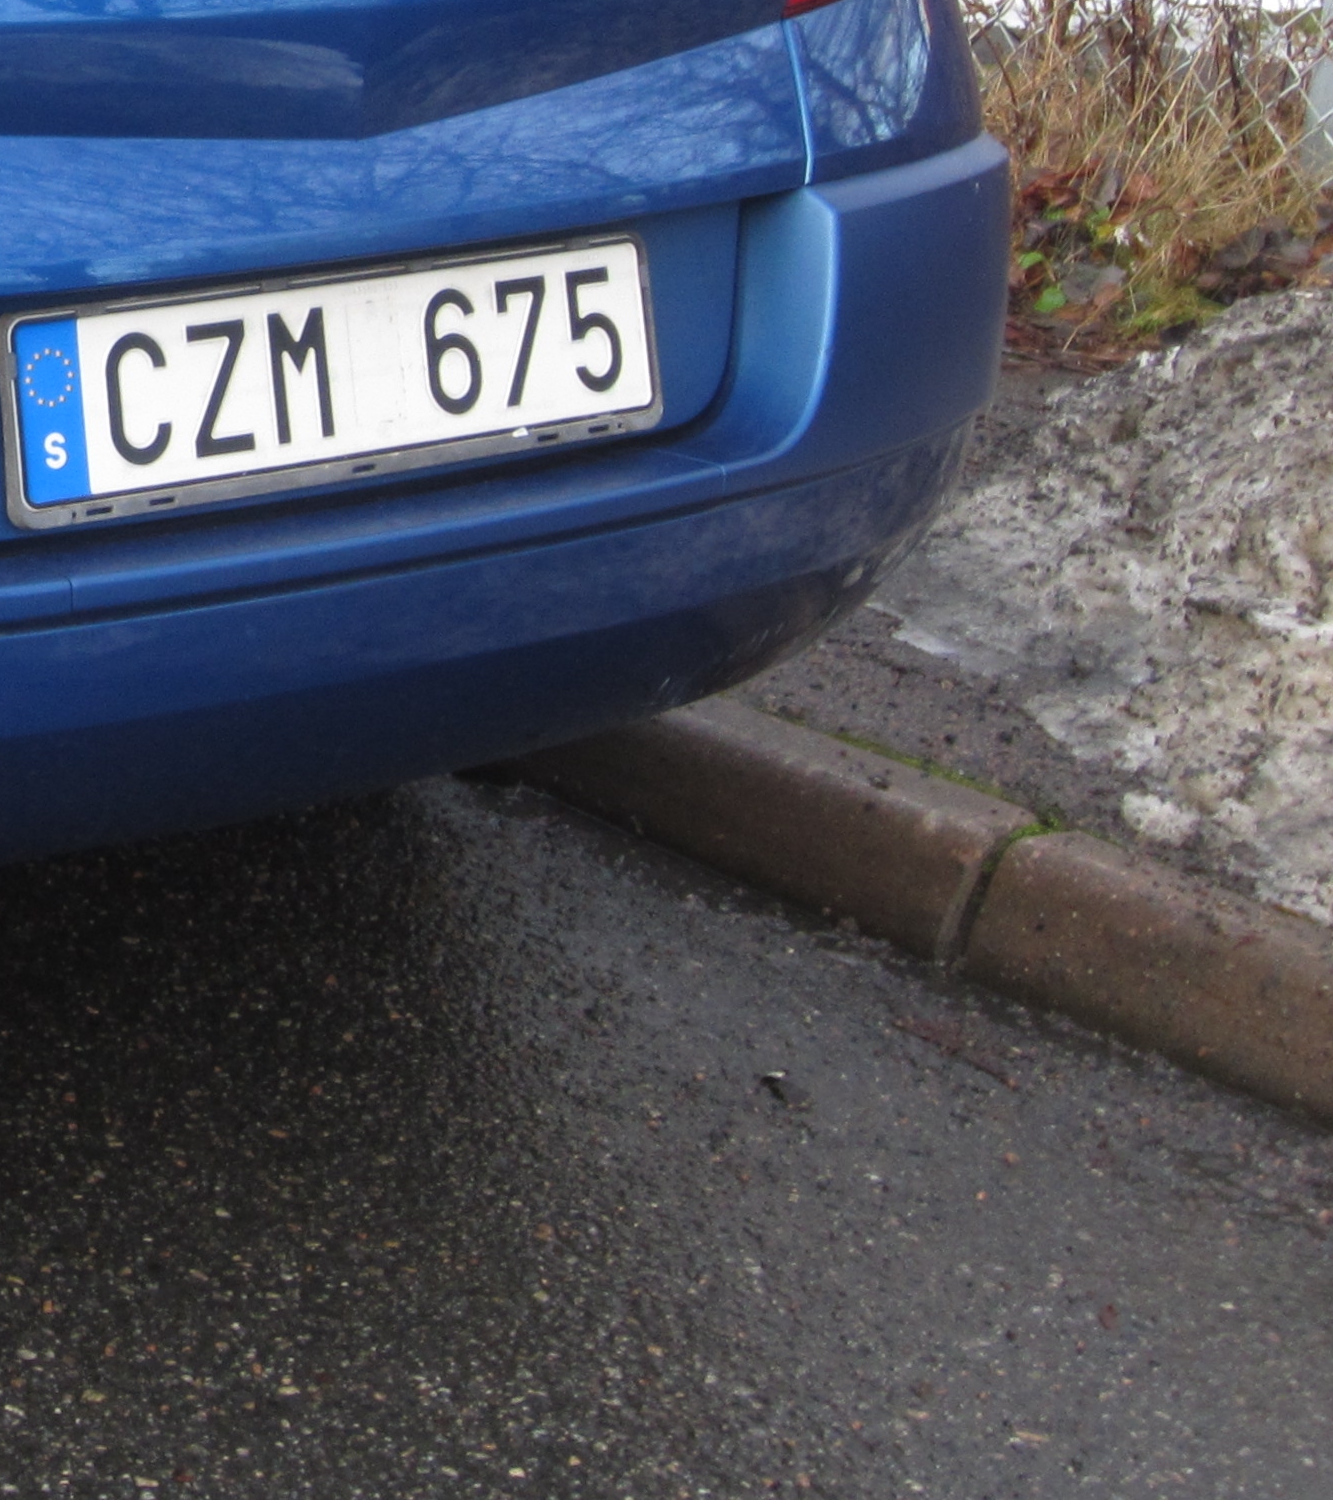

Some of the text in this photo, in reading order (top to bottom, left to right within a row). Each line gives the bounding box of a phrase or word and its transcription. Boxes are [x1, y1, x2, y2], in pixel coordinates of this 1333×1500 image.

[104, 266, 623, 466] CZM 675
[45, 432, 68, 471] S
